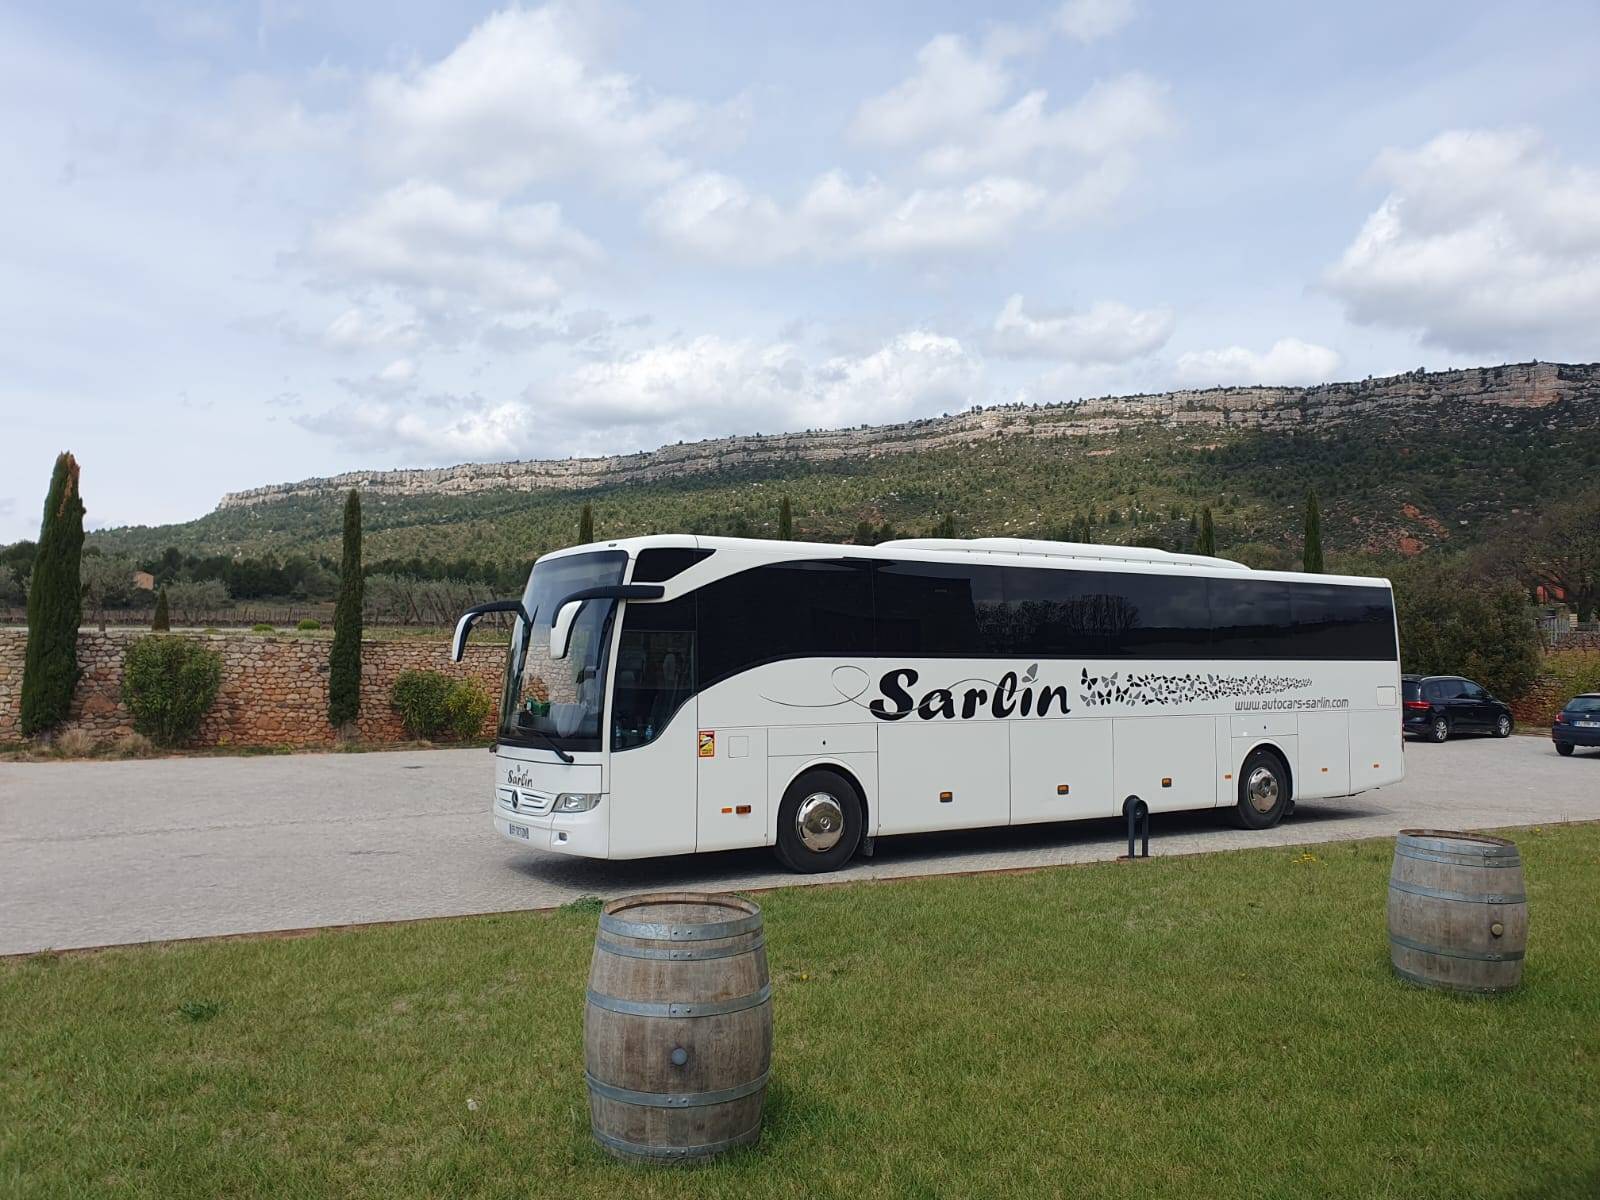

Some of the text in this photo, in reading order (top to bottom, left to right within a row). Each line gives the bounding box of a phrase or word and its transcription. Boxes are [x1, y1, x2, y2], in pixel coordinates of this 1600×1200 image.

[869, 667, 1071, 721] Sarlin
[1234, 697, 1349, 711] www.autocars-sarlin.com
[507, 769, 533, 788] Sarlin
